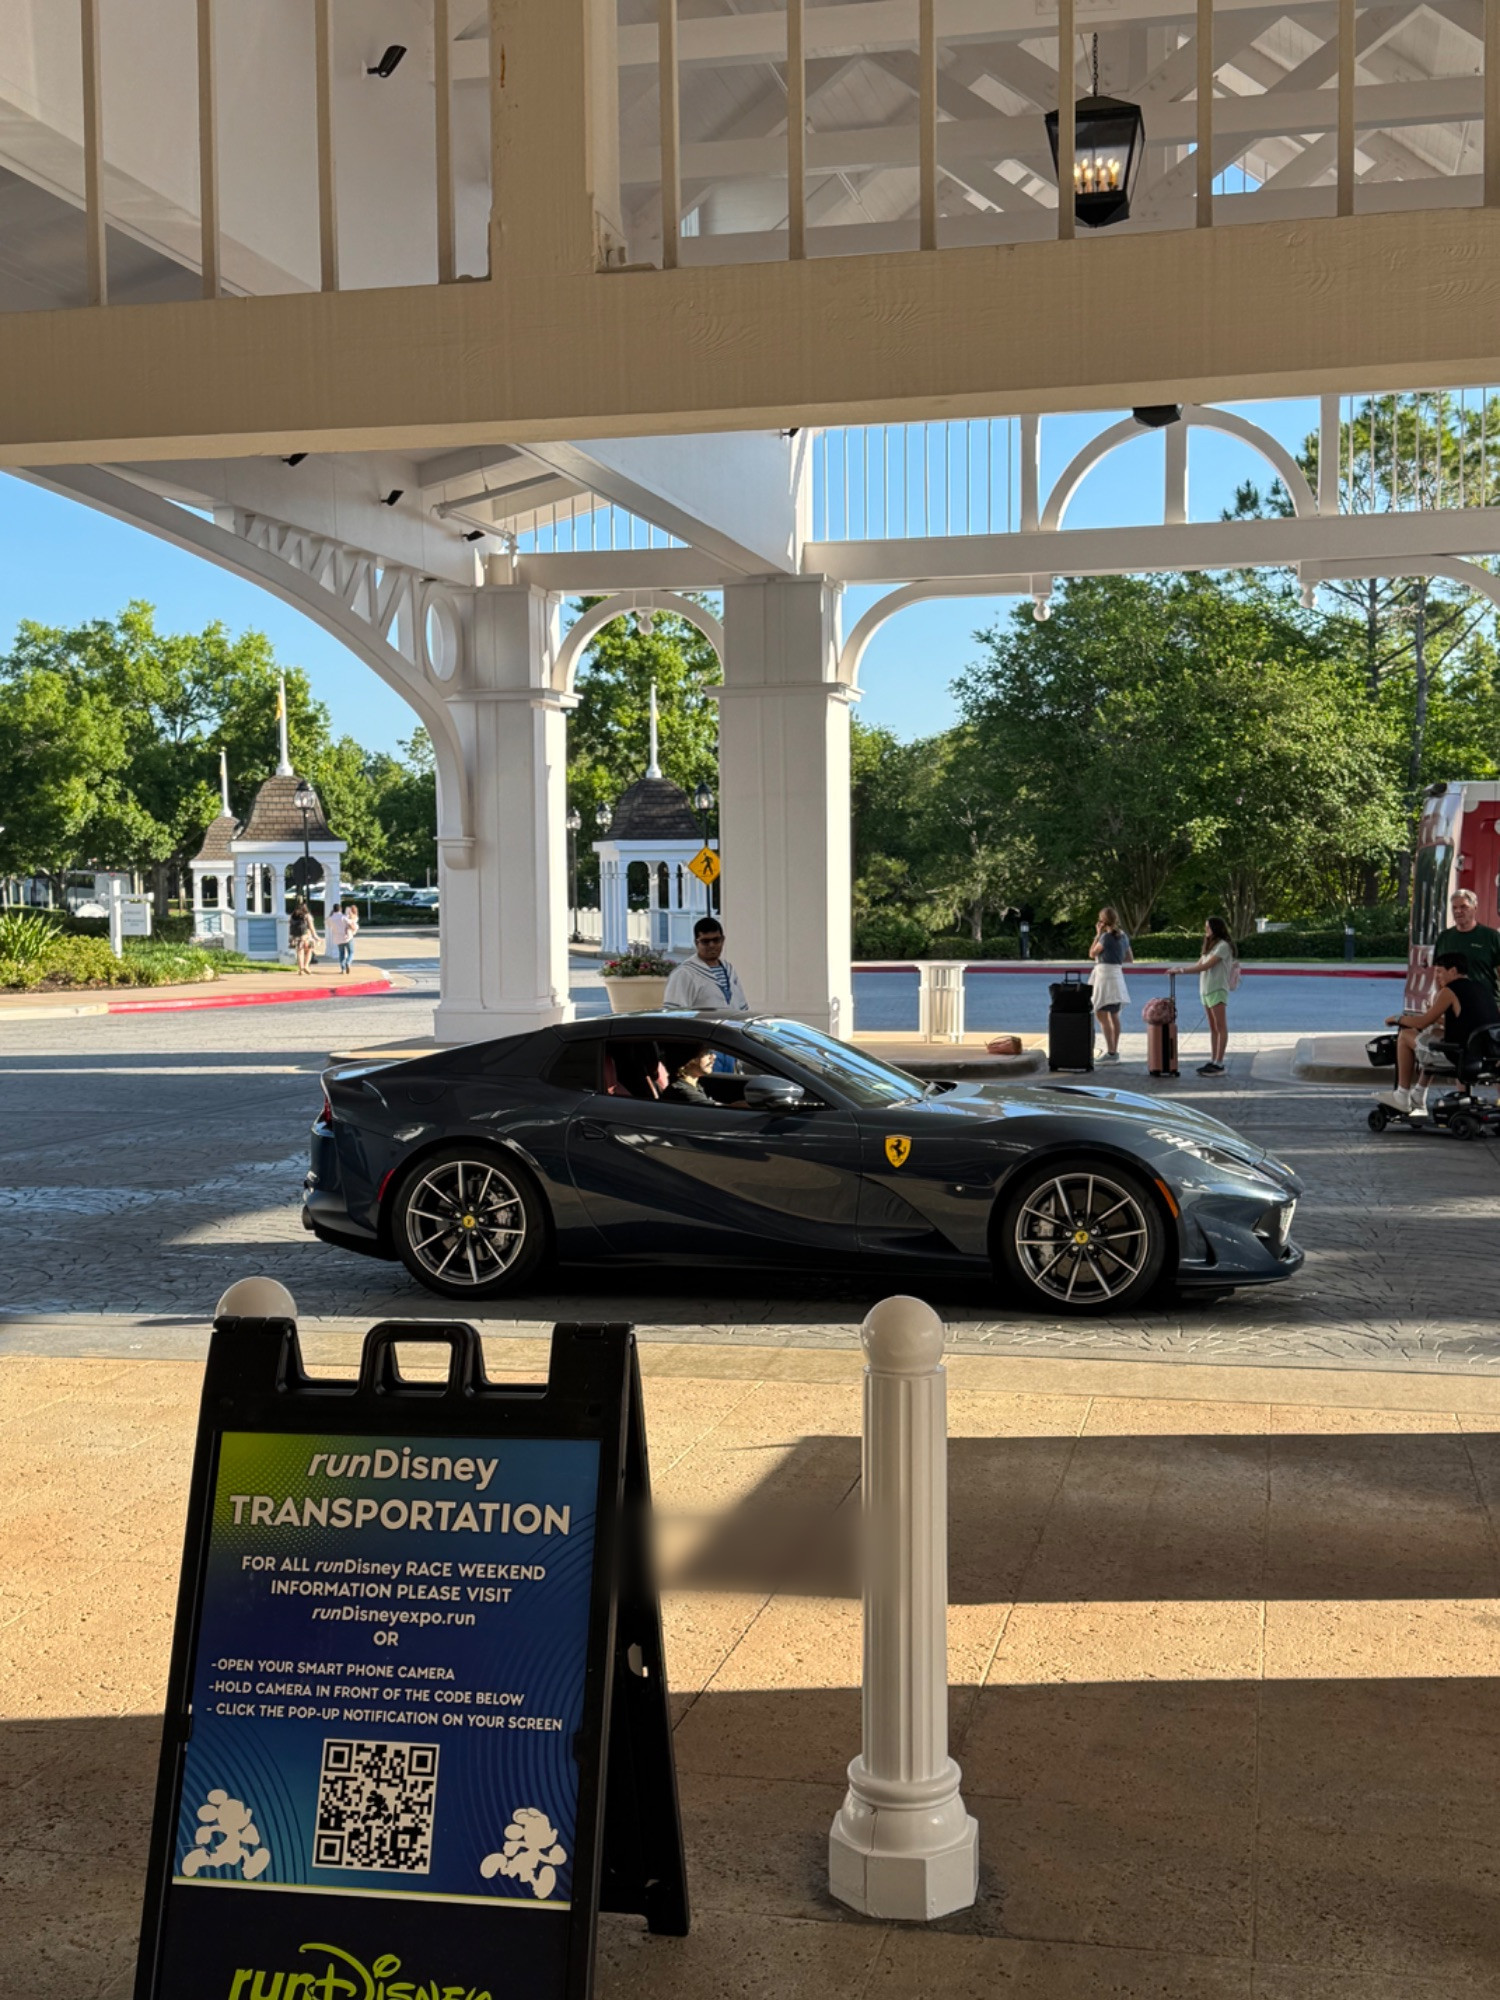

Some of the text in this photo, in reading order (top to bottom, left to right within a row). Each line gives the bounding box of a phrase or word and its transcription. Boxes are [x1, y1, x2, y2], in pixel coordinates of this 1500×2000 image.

[307, 1446, 499, 1491] runDisney
[229, 1495, 571, 1536] TRANSPORTATION
[241, 1555, 546, 1581] FOR ALL runDisney RACE WEEKEND
[271, 1579, 512, 1603] INFORMATION PLEASE VISIT
[311, 1606, 476, 1628] runDisneyexpo.run
[373, 1630, 399, 1646] OR
[257, 1660, 294, 1673] YOUR
[297, 1661, 344, 1675] SMART
[346, 1663, 394, 1678] PHONE
[397, 1665, 455, 1681] CAMERA
[255, 1682, 312, 1697] CAMERA
[315, 1684, 331, 1697] IN
[333, 1685, 380, 1700] FRONT
[382, 1687, 402, 1701] OF
[404, 1688, 431, 1702] THE
[433, 1689, 473, 1704] CODE
[475, 1691, 525, 1707] BELOW
[216, 1702, 256, 1716] CLICK
[259, 1704, 285, 1717] THE
[288, 1705, 340, 1720] POP-UP
[342, 1708, 439, 1726] NOTIFICATION
[442, 1712, 464, 1726] ON
[467, 1714, 505, 1729] YOUR
[507, 1715, 563, 1732] SCREEN
